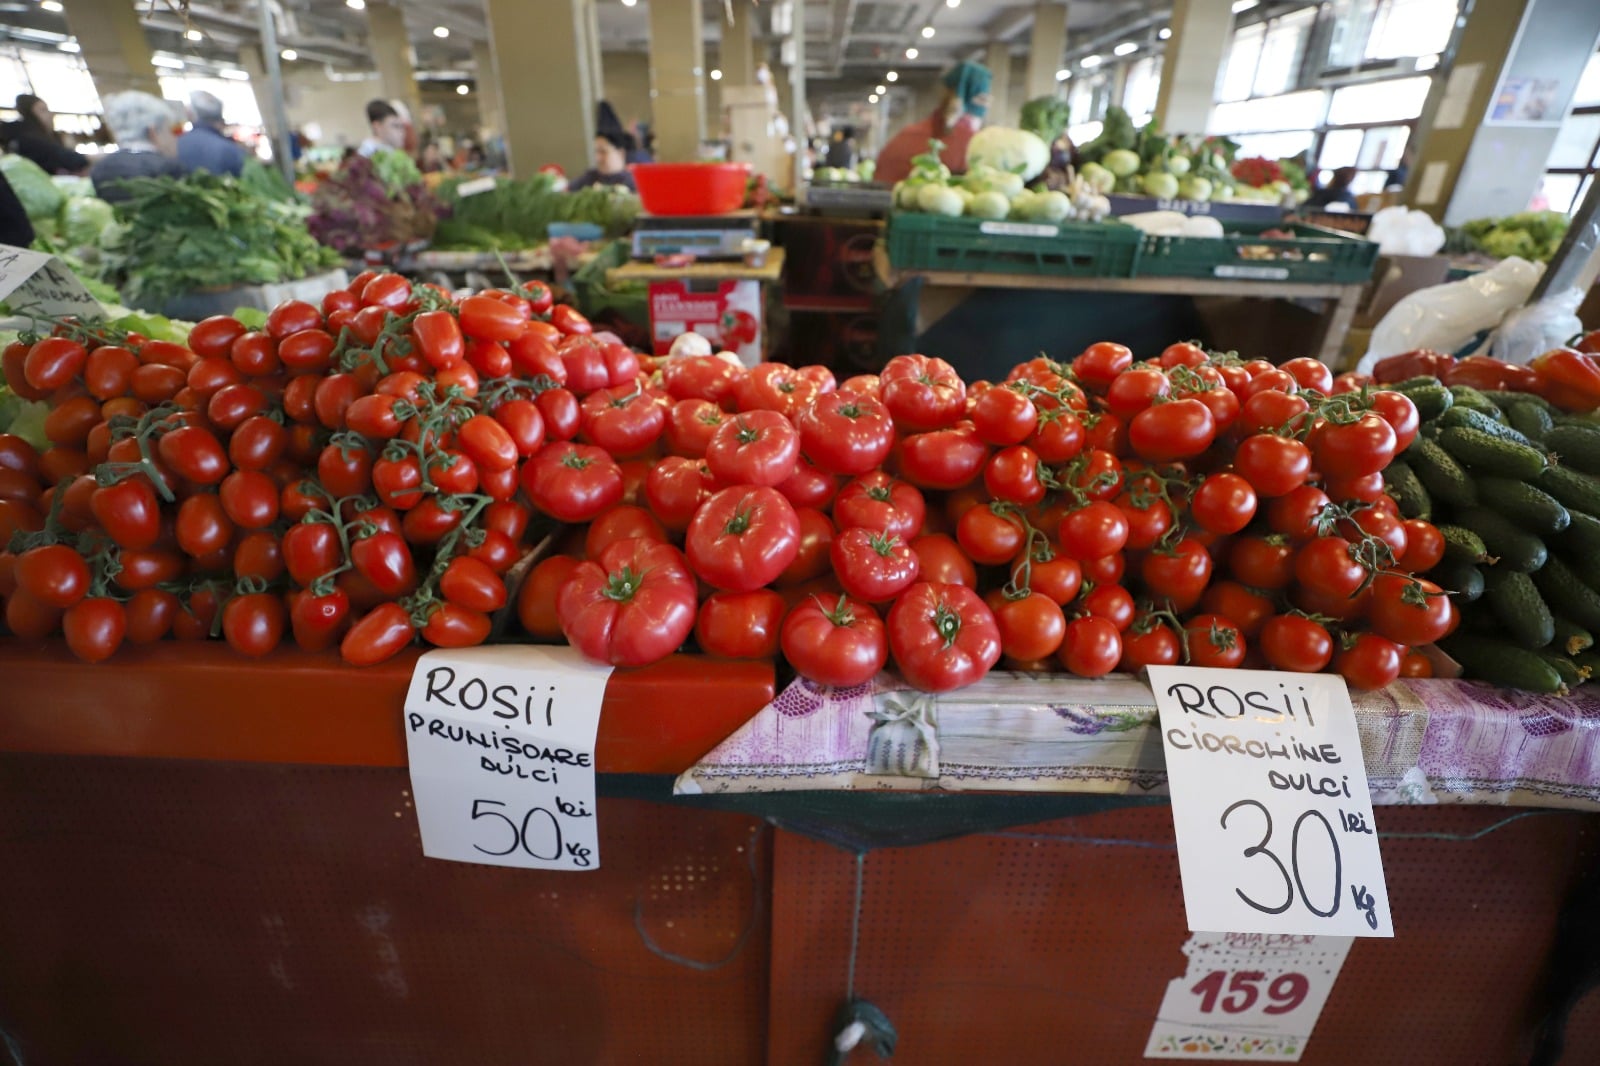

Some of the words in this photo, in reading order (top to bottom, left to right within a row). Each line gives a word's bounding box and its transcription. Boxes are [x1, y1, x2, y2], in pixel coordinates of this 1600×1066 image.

[472, 800, 562, 860] 50
[1221, 799, 1341, 917] 30
[1191, 970, 1309, 1015] 159
